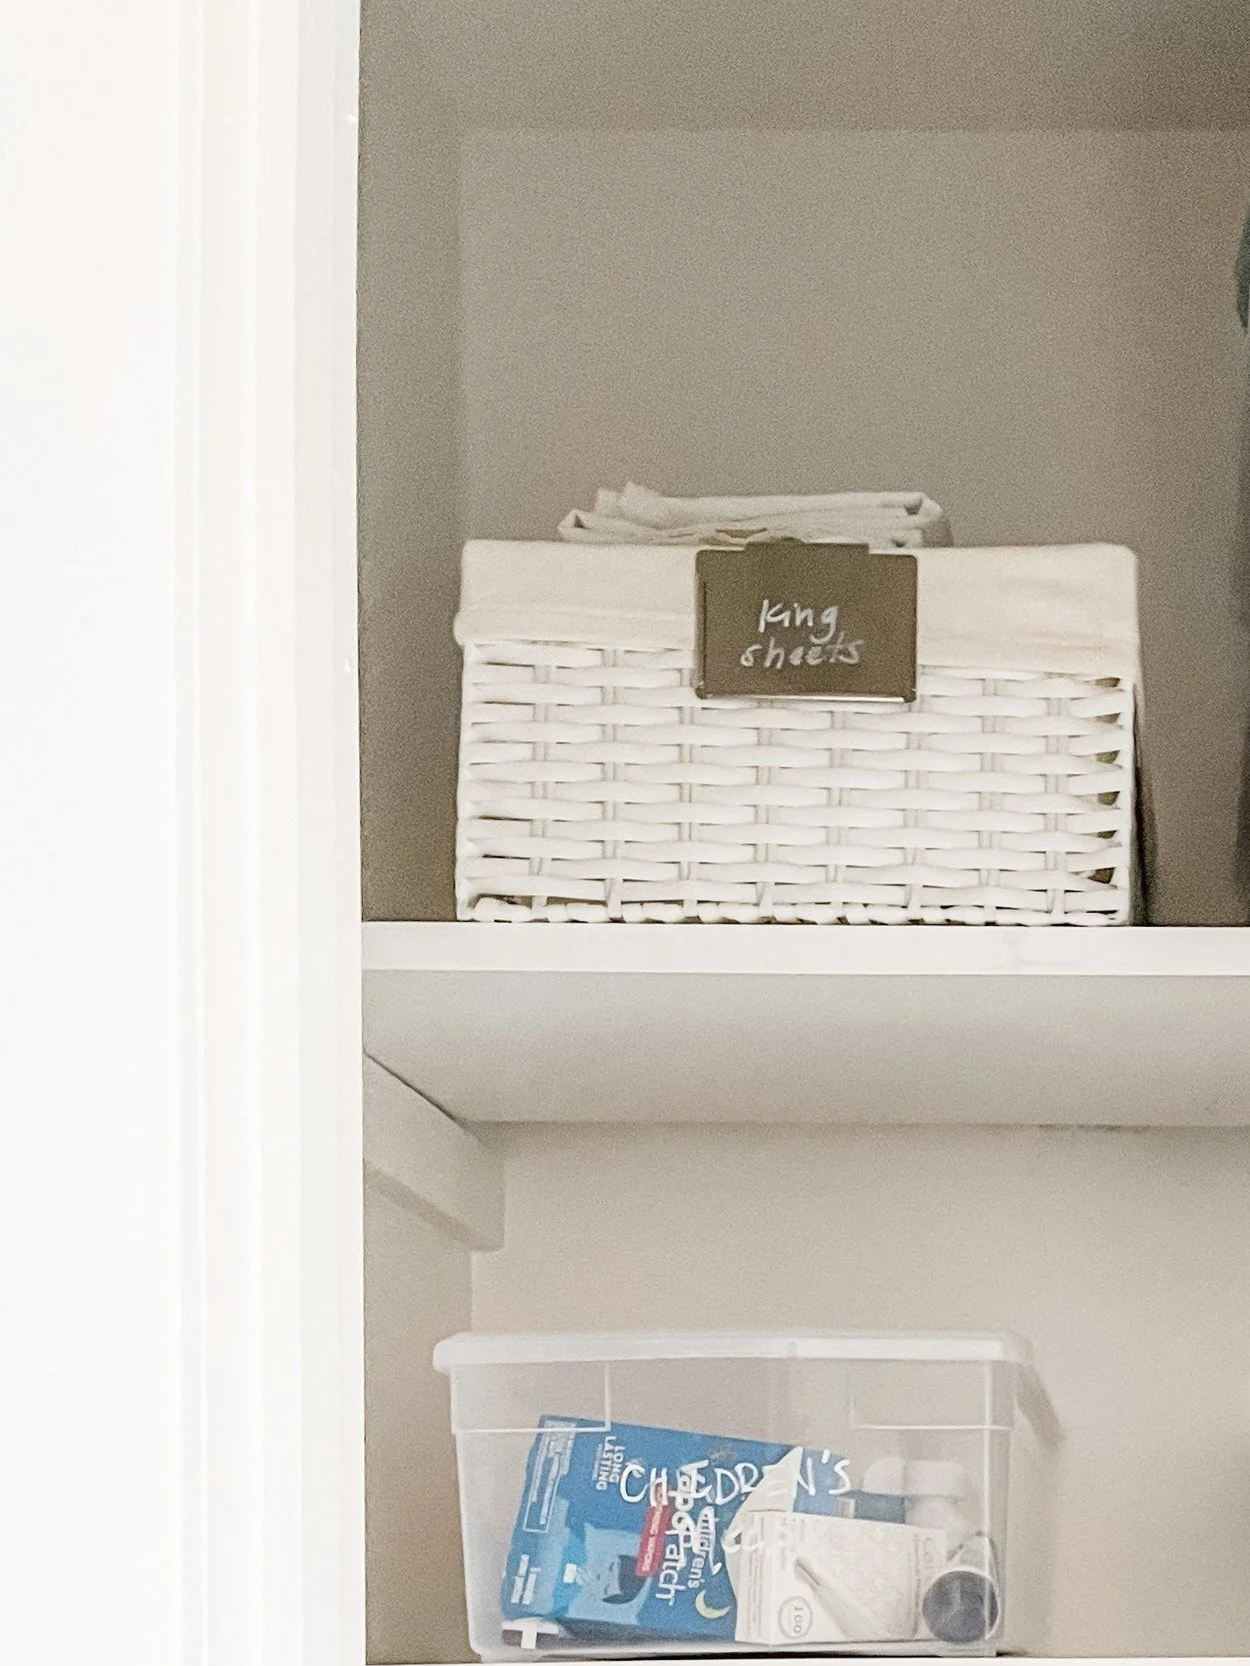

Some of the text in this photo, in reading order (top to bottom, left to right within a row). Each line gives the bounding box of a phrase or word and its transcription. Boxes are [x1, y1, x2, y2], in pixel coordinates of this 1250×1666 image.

[595, 435, 617, 491] LASTING
[608, 445, 626, 484] LONG
[758, 599, 838, 644] King
[740, 633, 864, 669] sheets
